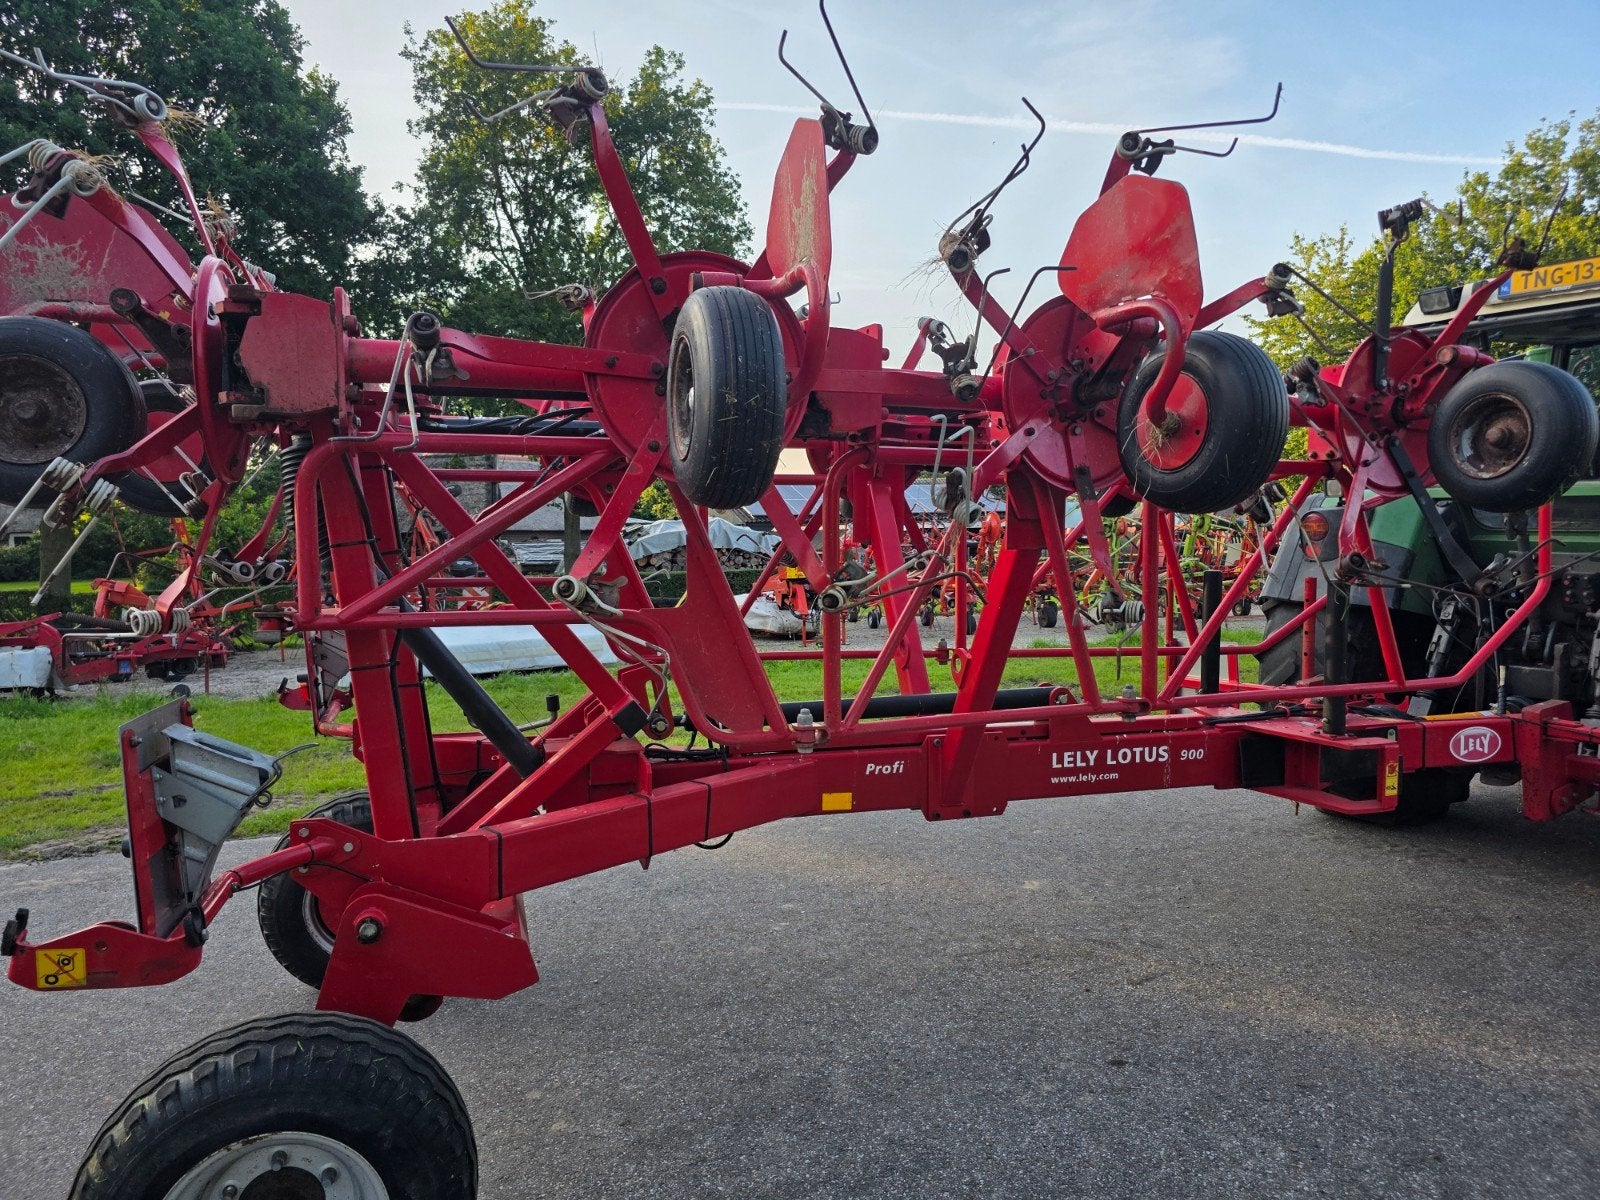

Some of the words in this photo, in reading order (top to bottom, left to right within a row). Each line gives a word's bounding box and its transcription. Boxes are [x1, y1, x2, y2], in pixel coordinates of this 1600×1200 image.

[1460, 732, 1490, 756] LELY
[1052, 750, 1098, 768] LELY
[1106, 745, 1168, 764] LOTUS
[1180, 749, 1204, 760] 900
[865, 760, 905, 775] Profi
[1051, 772, 1118, 783] www.lely.com
